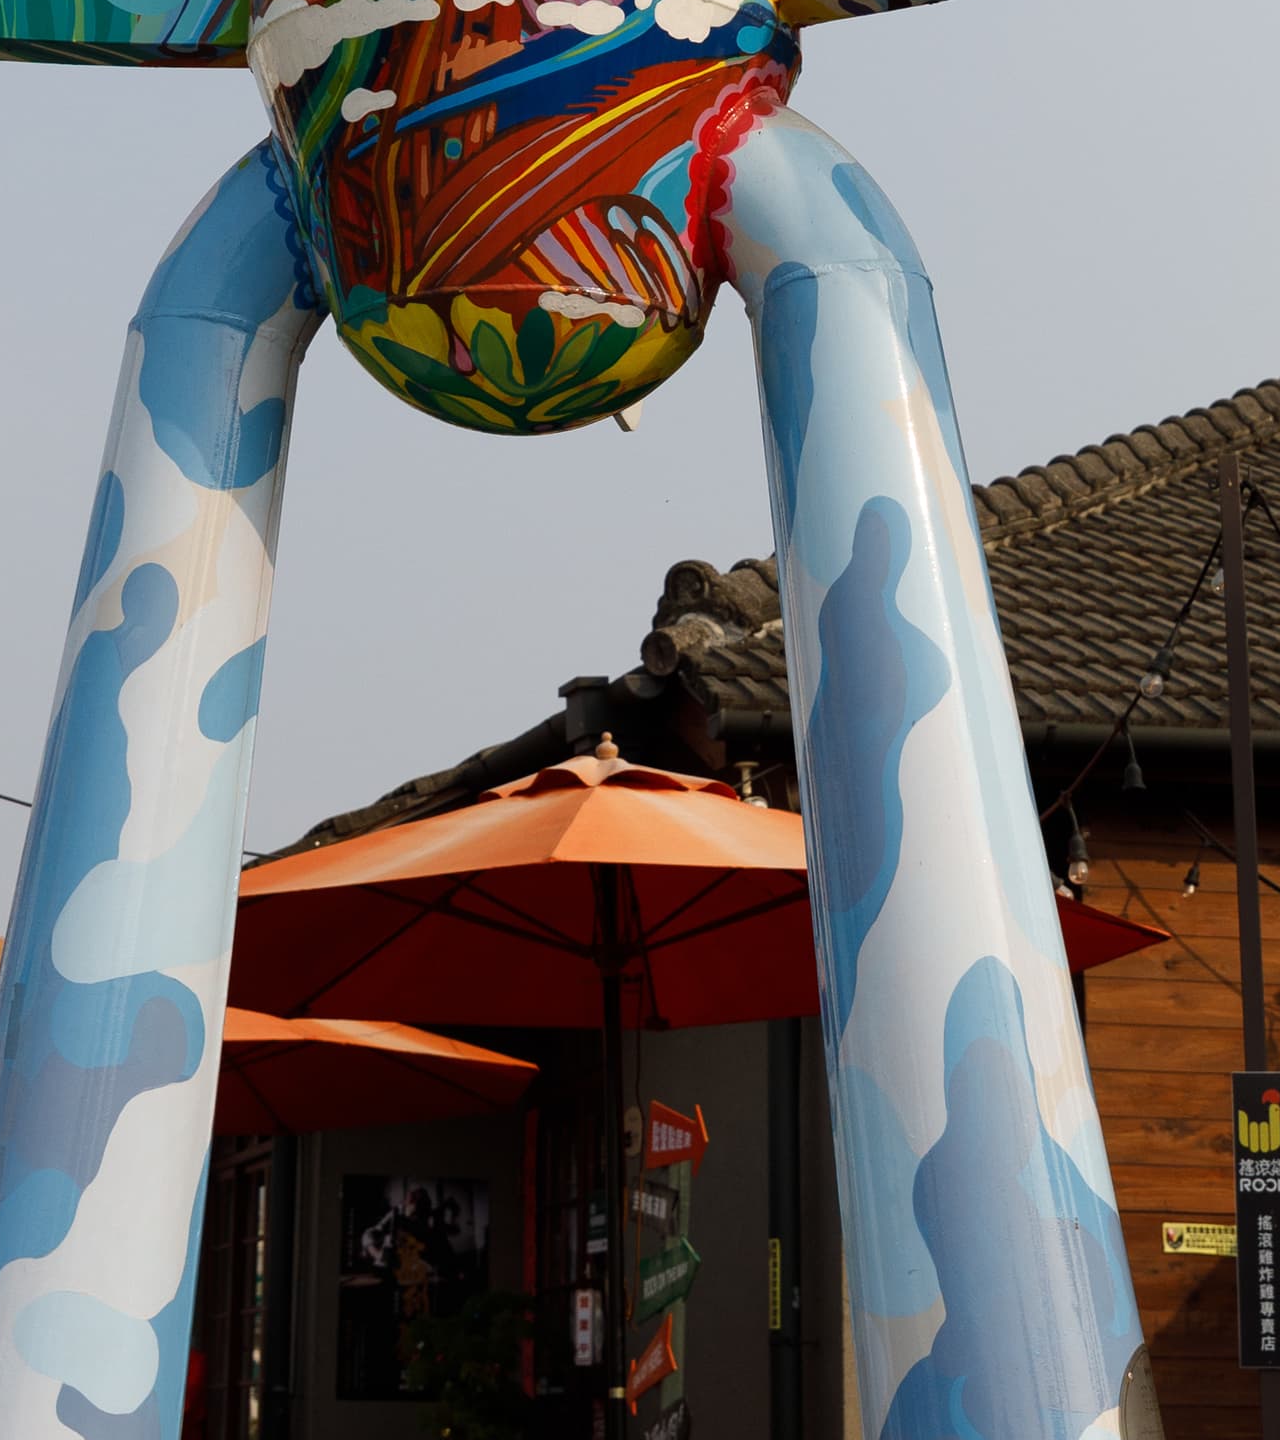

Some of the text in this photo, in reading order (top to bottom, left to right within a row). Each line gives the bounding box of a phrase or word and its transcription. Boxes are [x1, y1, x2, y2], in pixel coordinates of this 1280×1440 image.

[1257, 1214, 1276, 1352] 搖滾雞炸雞專賣店
